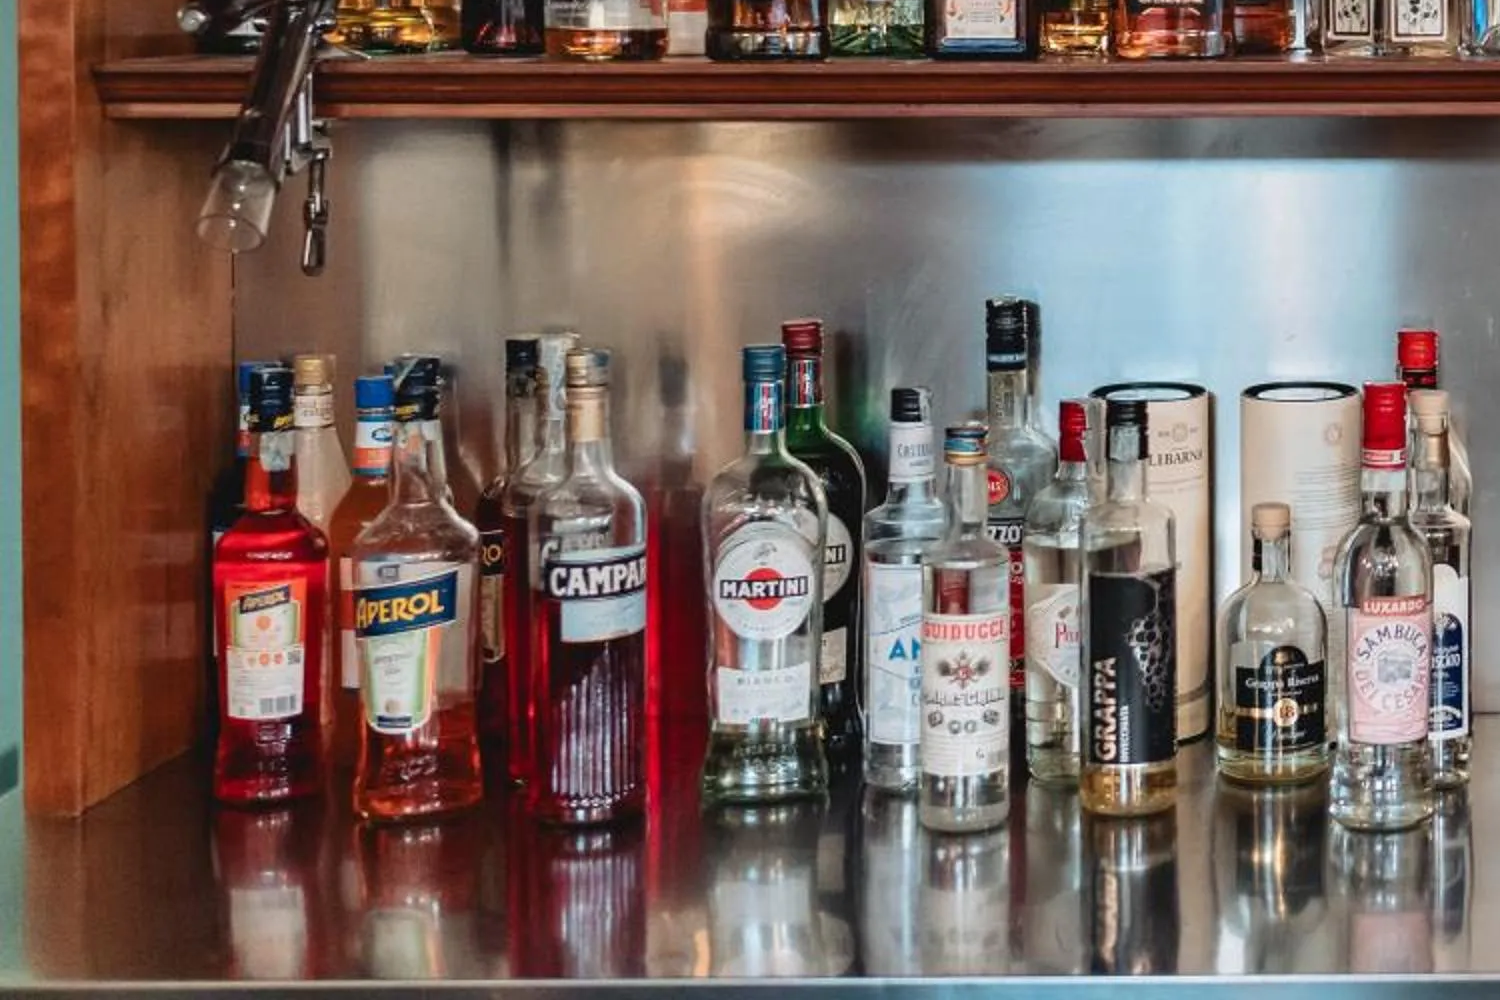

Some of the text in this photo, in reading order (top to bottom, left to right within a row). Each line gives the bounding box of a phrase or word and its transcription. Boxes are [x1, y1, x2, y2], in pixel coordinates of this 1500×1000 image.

[723, 578, 807, 597] MARTINI
[356, 589, 445, 629] APEROL
[1363, 601, 1425, 613] LUXARDO
[1356, 625, 1427, 660] SAMBUCA
[1093, 656, 1117, 760] GRAPPA
